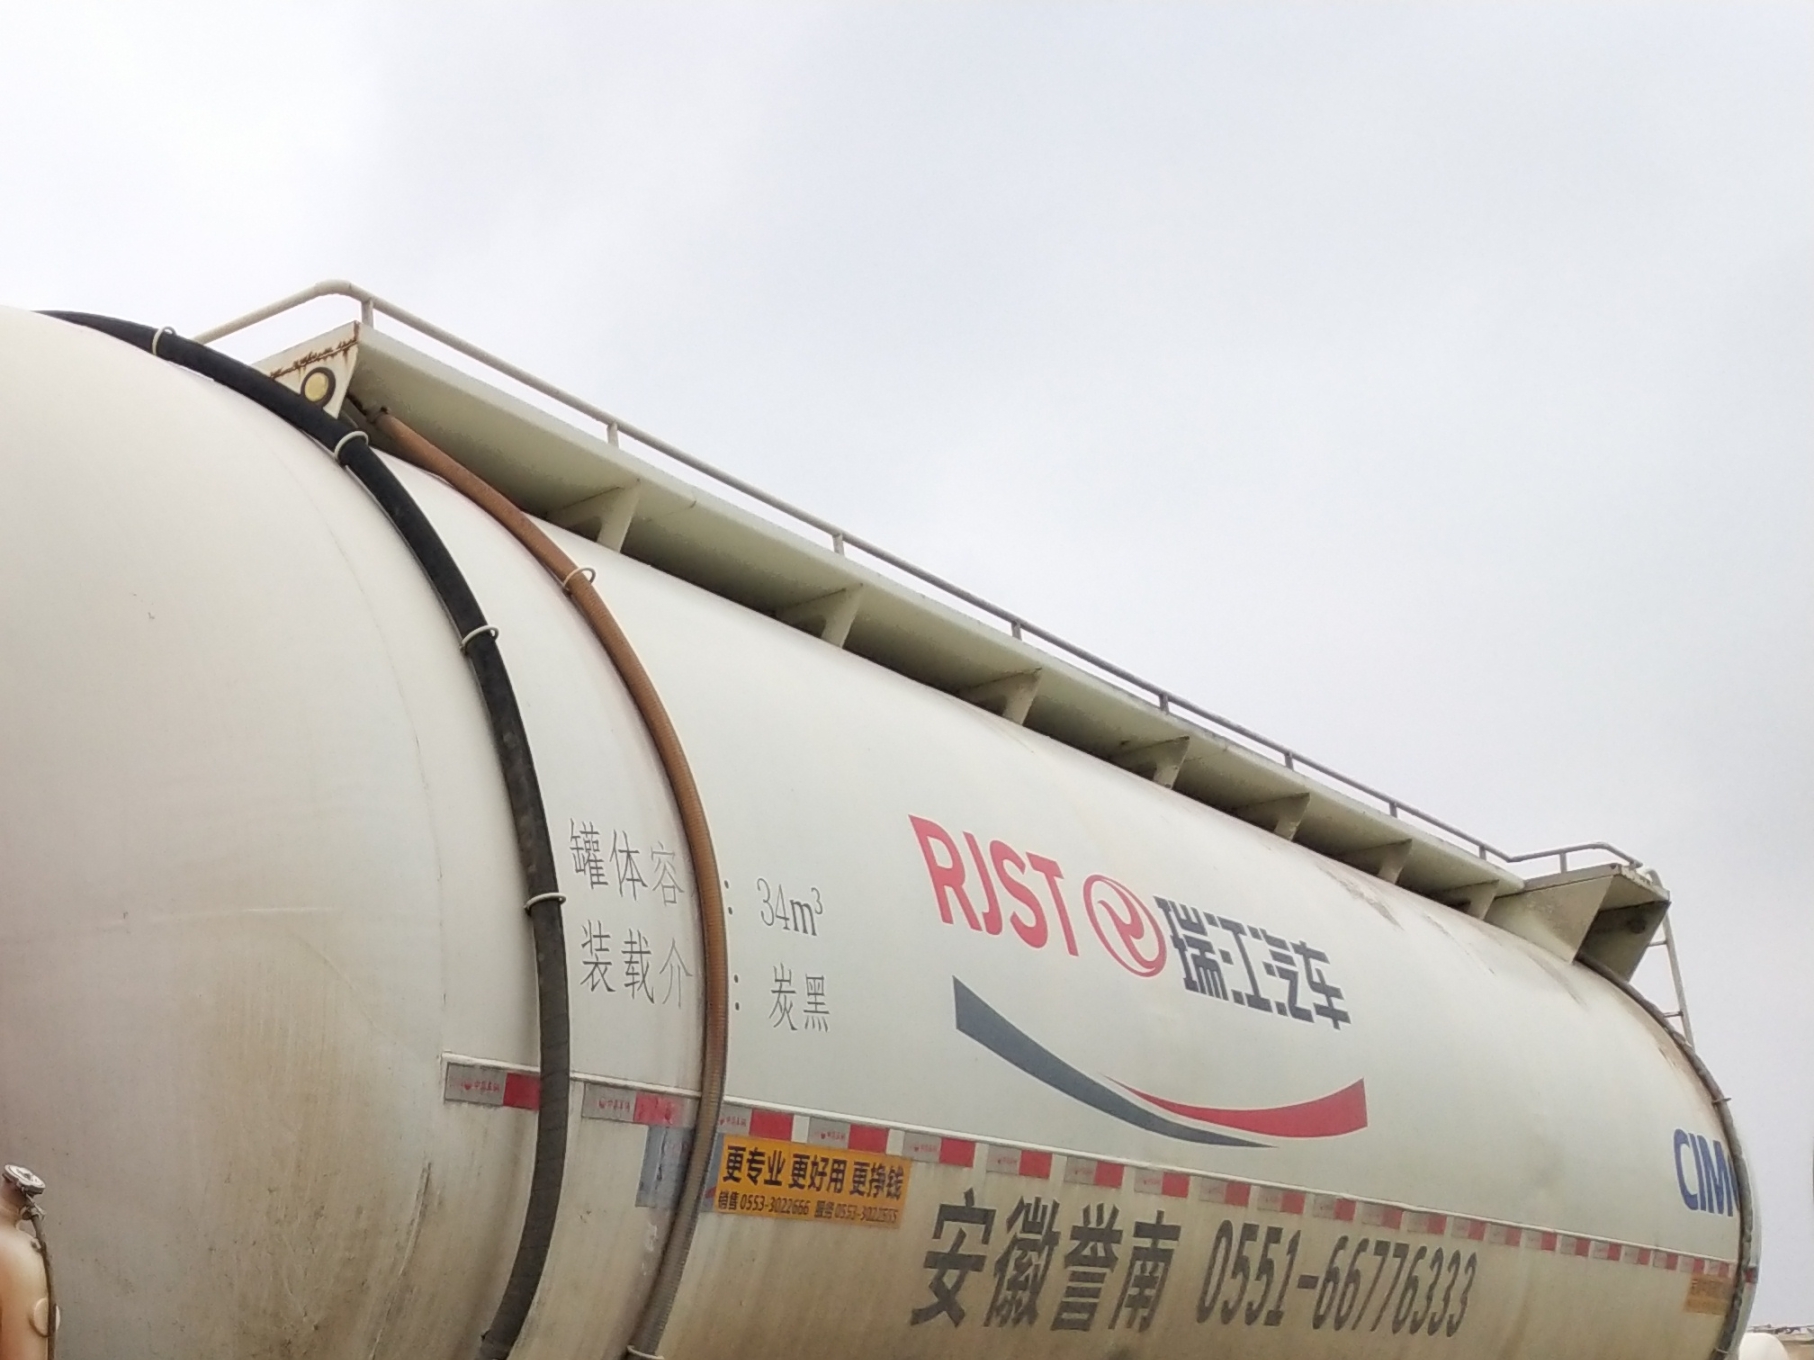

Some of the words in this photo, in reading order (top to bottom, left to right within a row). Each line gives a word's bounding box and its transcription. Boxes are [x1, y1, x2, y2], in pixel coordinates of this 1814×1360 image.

[908, 814, 1079, 957] RJST
[769, 962, 831, 1033] 炭黑
[1153, 895, 1351, 1030] 瑞江汽车
[722, 1145, 786, 1187] 更专业
[788, 1152, 848, 1194] 更好用
[849, 1160, 905, 1201] 更挣钱
[740, 1193, 811, 1216] 0553-3022666
[1673, 1128, 1740, 1217] CIM
[910, 1187, 1182, 1333] 安徽誉南
[1196, 1218, 1478, 1338] 0551-66776333
